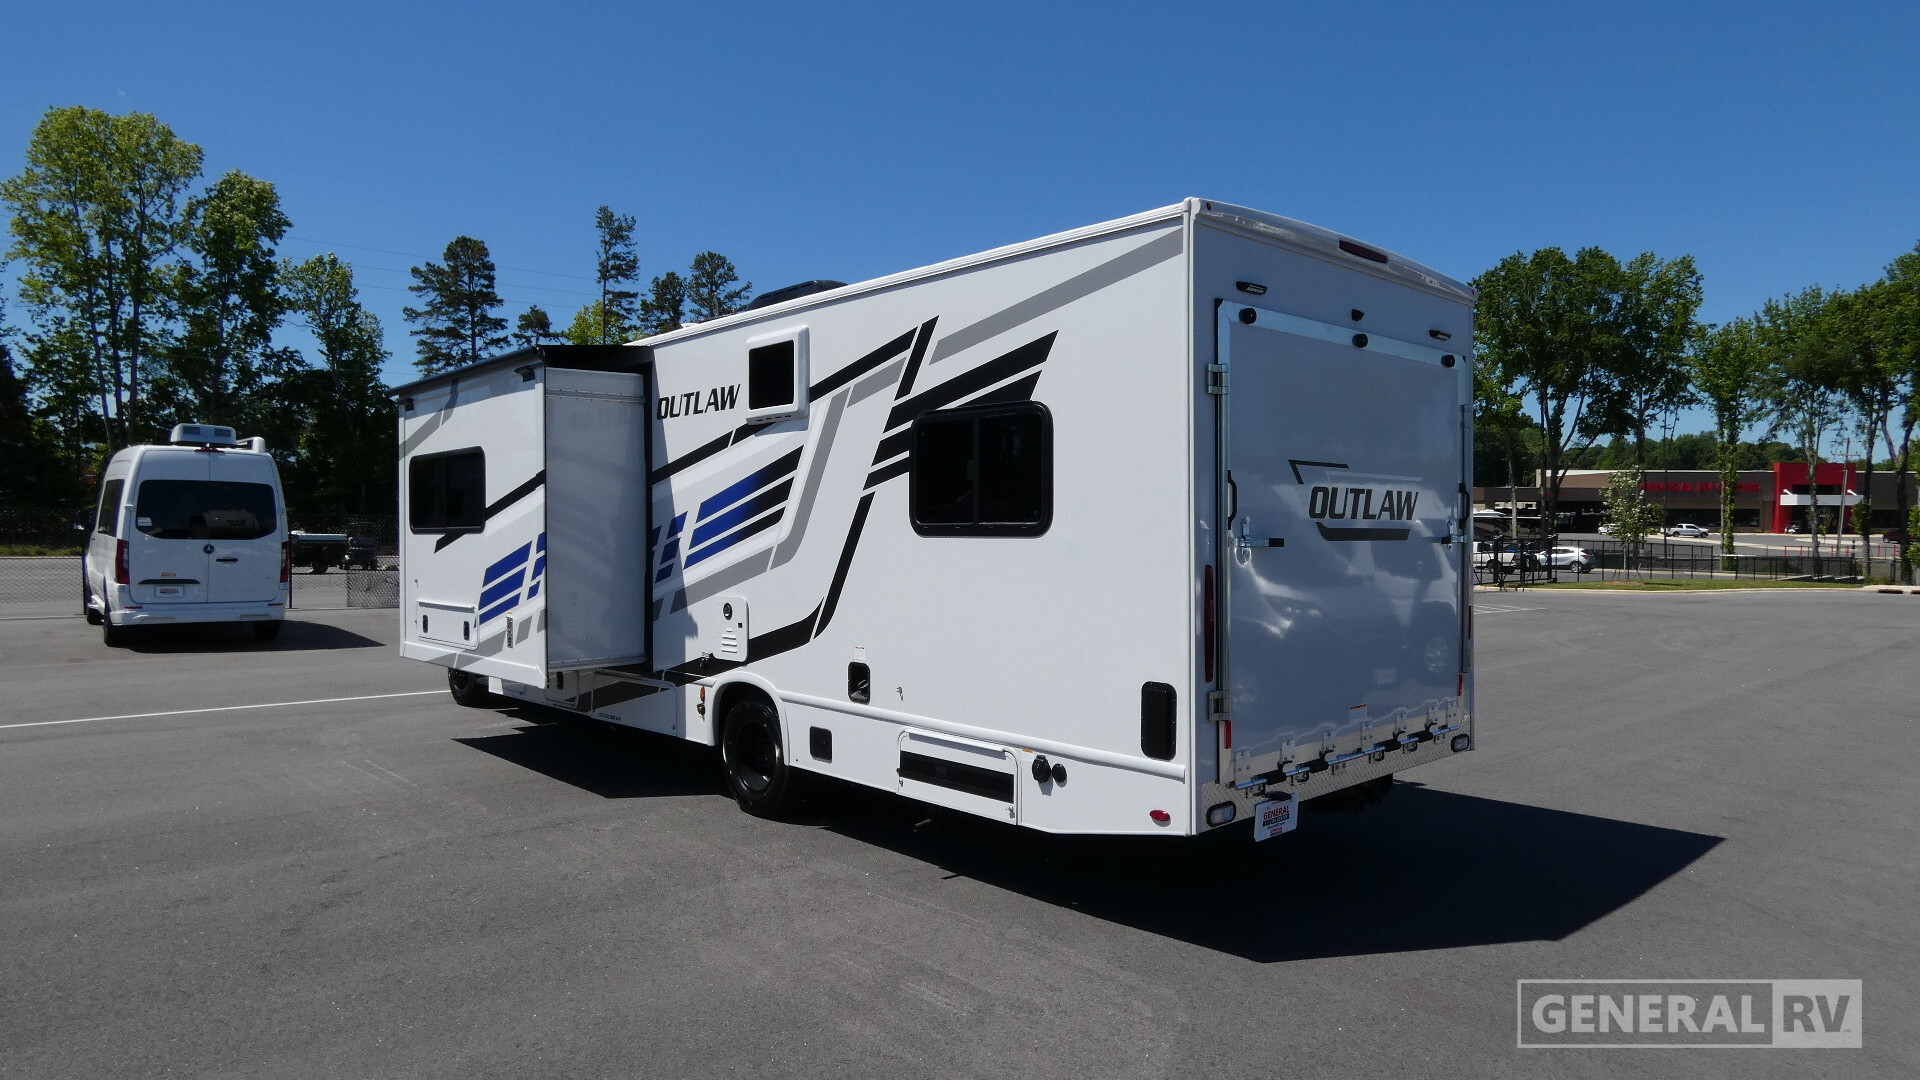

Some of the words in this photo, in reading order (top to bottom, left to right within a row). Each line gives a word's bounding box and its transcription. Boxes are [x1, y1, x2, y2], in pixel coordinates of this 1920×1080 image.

[656, 383, 741, 420] OUTLAW
[1308, 486, 1419, 521] OUTLAW
[1263, 806, 1290, 820] GENERAL
